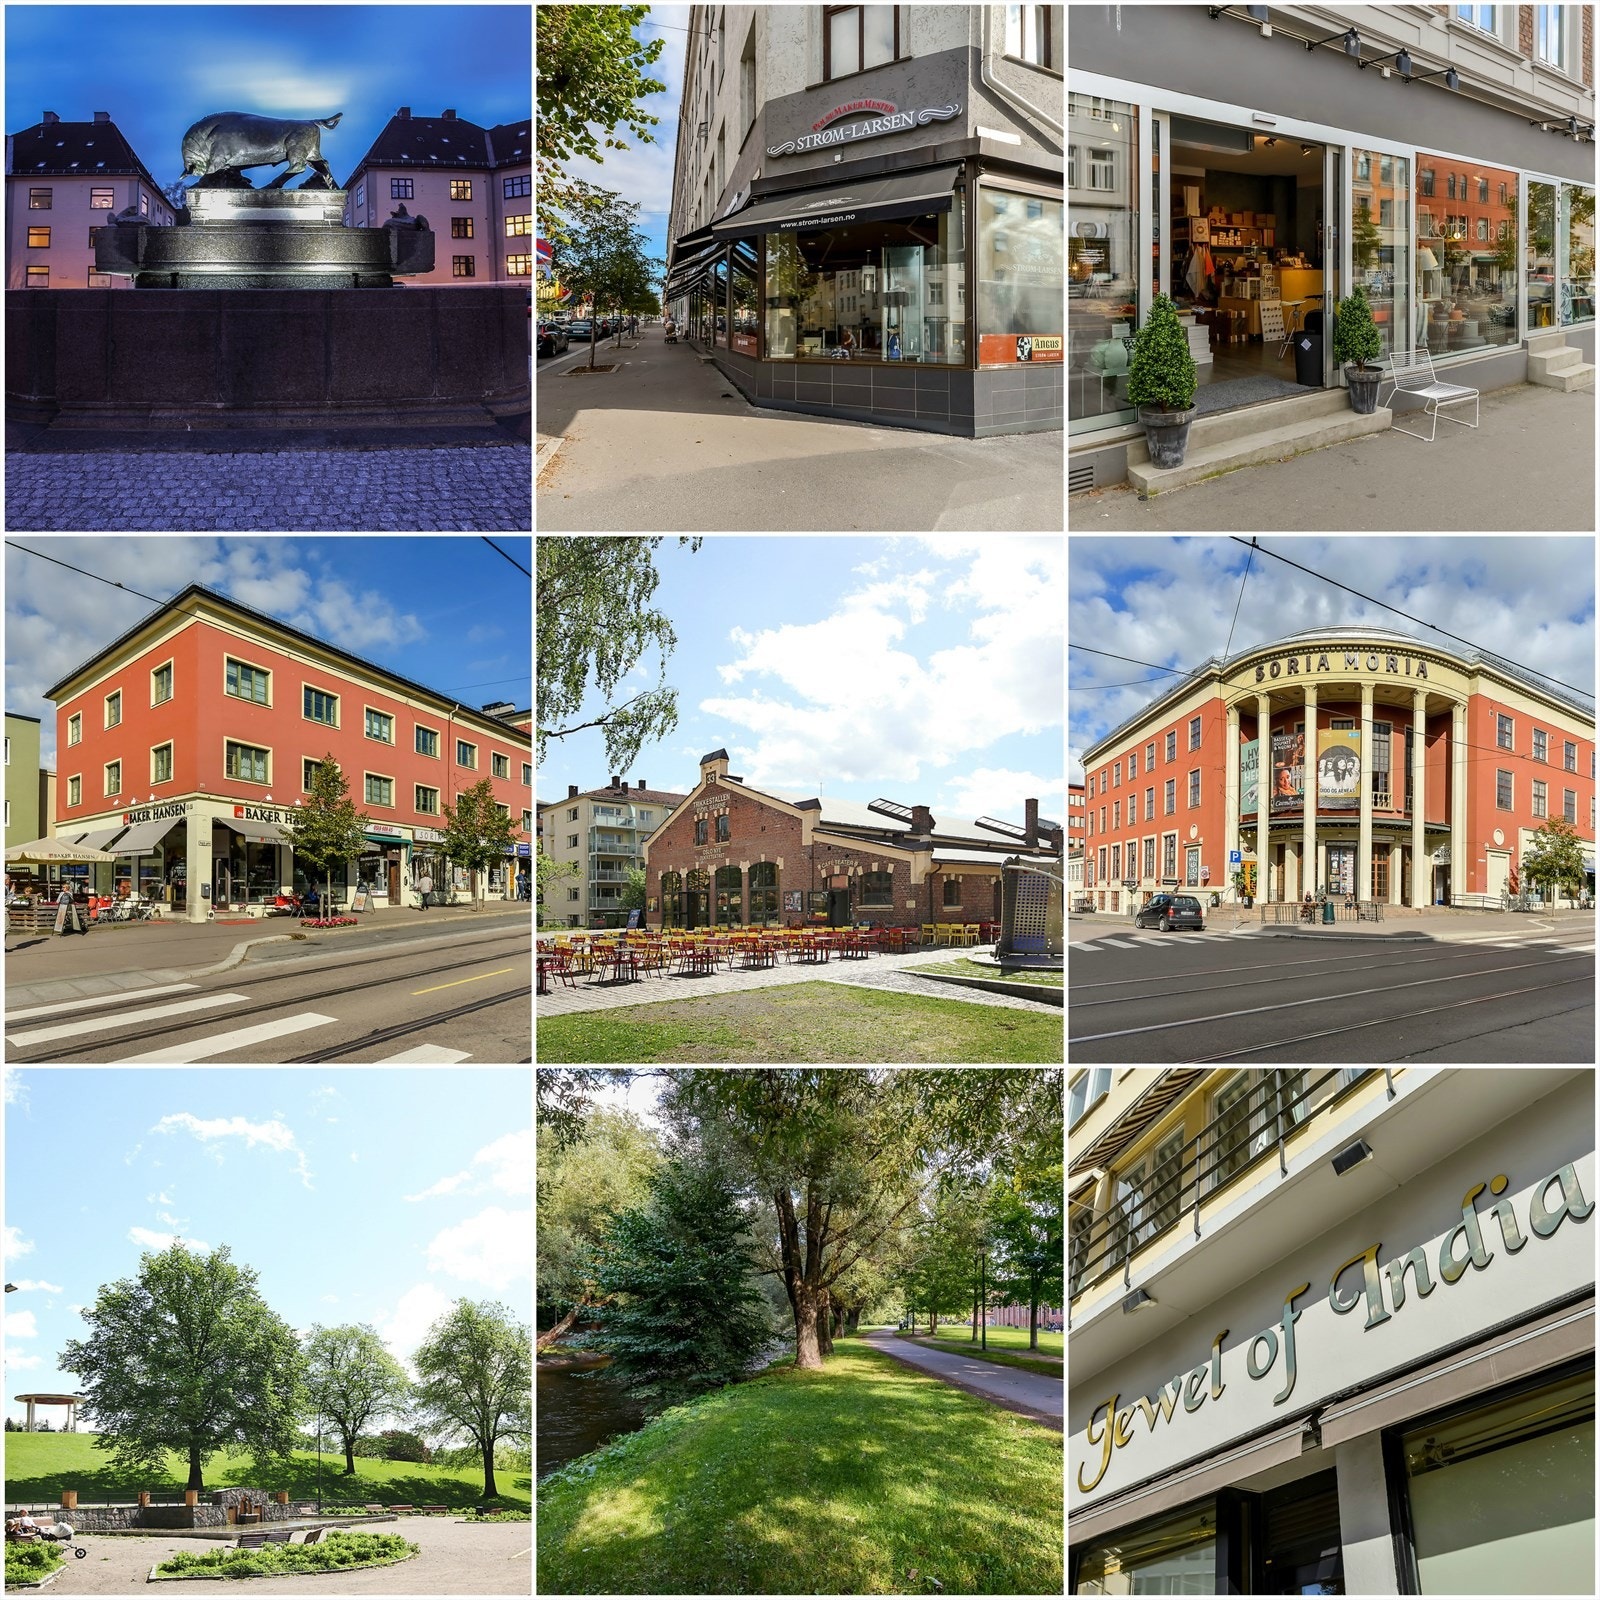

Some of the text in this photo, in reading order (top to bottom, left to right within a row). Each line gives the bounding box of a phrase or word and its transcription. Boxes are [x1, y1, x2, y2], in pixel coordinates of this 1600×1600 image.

[796, 110, 915, 151] STRØM-LARSEN
[780, 213, 856, 229] www.strom-larsen.no
[1255, 650, 1429, 683] SORIA MORIA
[1247, 746, 1259, 760] HV
[1241, 758, 1259, 772] SKJE
[706, 773, 715, 785] 33
[129, 802, 187, 825] BAKER HANSEN
[245, 807, 282, 824] BAKER
[1077, 1162, 1596, 1494] Jewel of India
